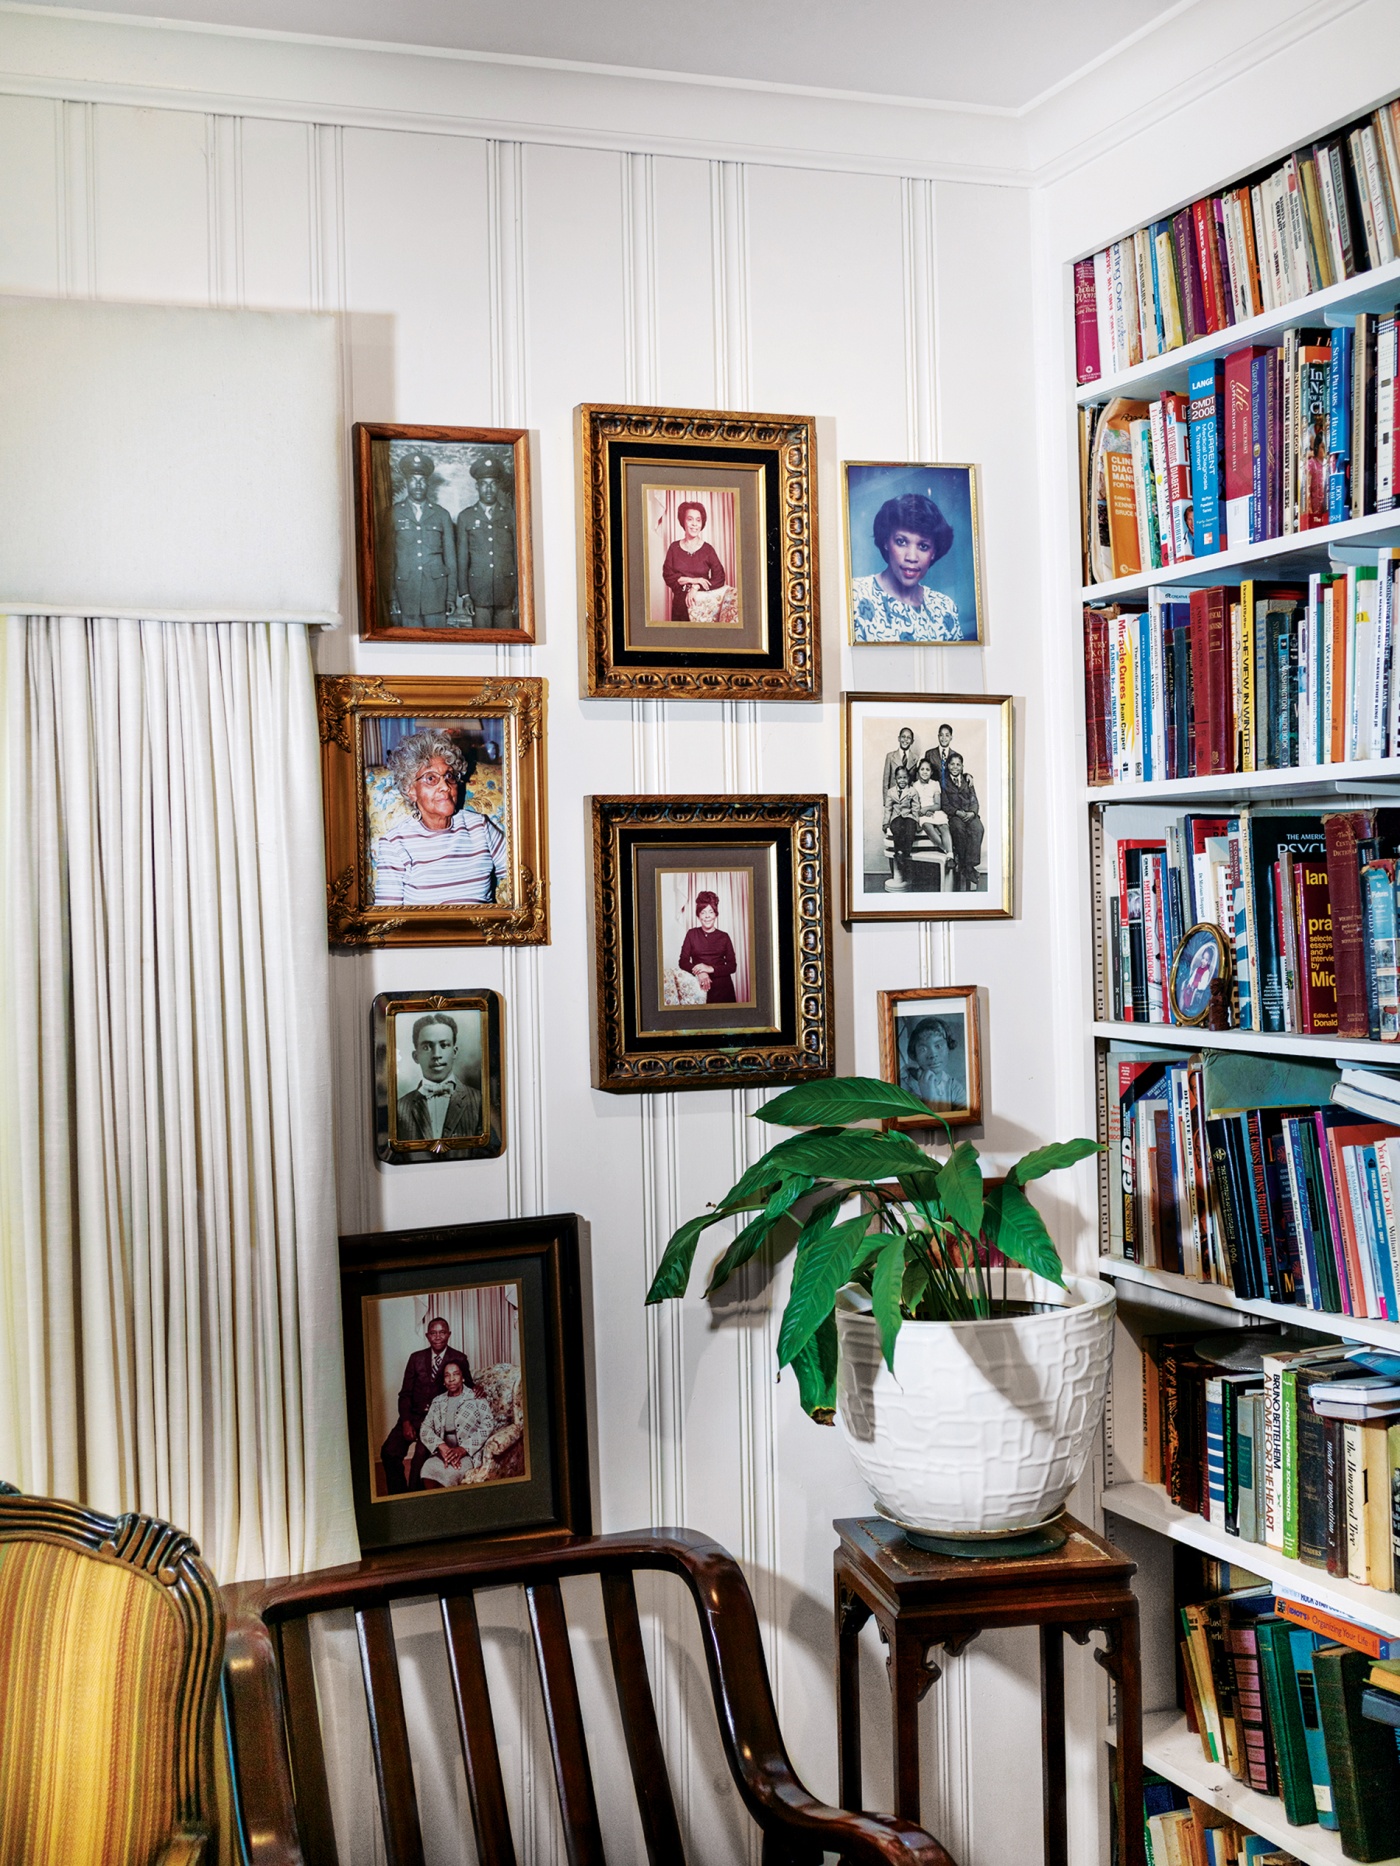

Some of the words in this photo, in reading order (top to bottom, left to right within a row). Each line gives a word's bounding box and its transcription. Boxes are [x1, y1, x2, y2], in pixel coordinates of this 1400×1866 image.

[1333, 153, 1343, 199] PHYSICIAN'S
[1339, 204, 1348, 243] HANDBOOK
[1113, 244, 1122, 280] arting
[1192, 377, 1213, 390] LANGE
[1252, 362, 1260, 392] Kevin
[1191, 396, 1215, 410] CMDT
[1230, 380, 1249, 413] life
[1192, 406, 1215, 420] 2008
[1168, 426, 1177, 464] REVERSING
[1331, 416, 1339, 448] HEALTH
[1170, 467, 1179, 499] DIABETES
[1115, 509, 1132, 517] BRUCE
[1117, 619, 1128, 664] Miracle
[1119, 665, 1127, 699] Cures
[1244, 693, 1250, 705] IN
[1306, 870, 1328, 884] lan
[1145, 926, 1153, 941] AND
[1309, 919, 1332, 935] pra
[1368, 904, 1376, 934] STUDY
[1370, 938, 1376, 950] OF
[1311, 962, 1319, 970] by
[1311, 972, 1336, 987] Mic
[1371, 954, 1379, 1009] LITERATURE
[1183, 1090, 1191, 1135] DELEGATE
[1248, 1116, 1258, 1134] THE
[1250, 1137, 1261, 1163] CROSS
[1377, 1143, 1387, 1164] You
[1122, 1137, 1133, 1194] GED
[1253, 1165, 1264, 1192] BURNS
[1380, 1165, 1390, 1188] Can
[1370, 1170, 1378, 1189] FRENCH
[1374, 1200, 1382, 1228] BEGINNERS
[1258, 1194, 1269, 1235] BRIGHTLY
[1357, 1214, 1365, 1245] MEDICINE
[1229, 1243, 1238, 1264] 1996
[1389, 1225, 1398, 1258] William
[1265, 1373, 1273, 1384] A
[1273, 1374, 1281, 1412] BRUNO
[1265, 1387, 1273, 1431] HOME
[1265, 1432, 1273, 1462] FOR
[1273, 1413, 1281, 1470] BETTELHEIM
[1327, 1441, 1335, 1476] modern
[1266, 1492, 1274, 1532] HEART
[1327, 1480, 1335, 1533] composition
[1328, 1538, 1335, 1546] 3
[1312, 1615, 1342, 1637] Organizing
[1343, 1628, 1355, 1641] Your
[1357, 1635, 1369, 1647] Life
